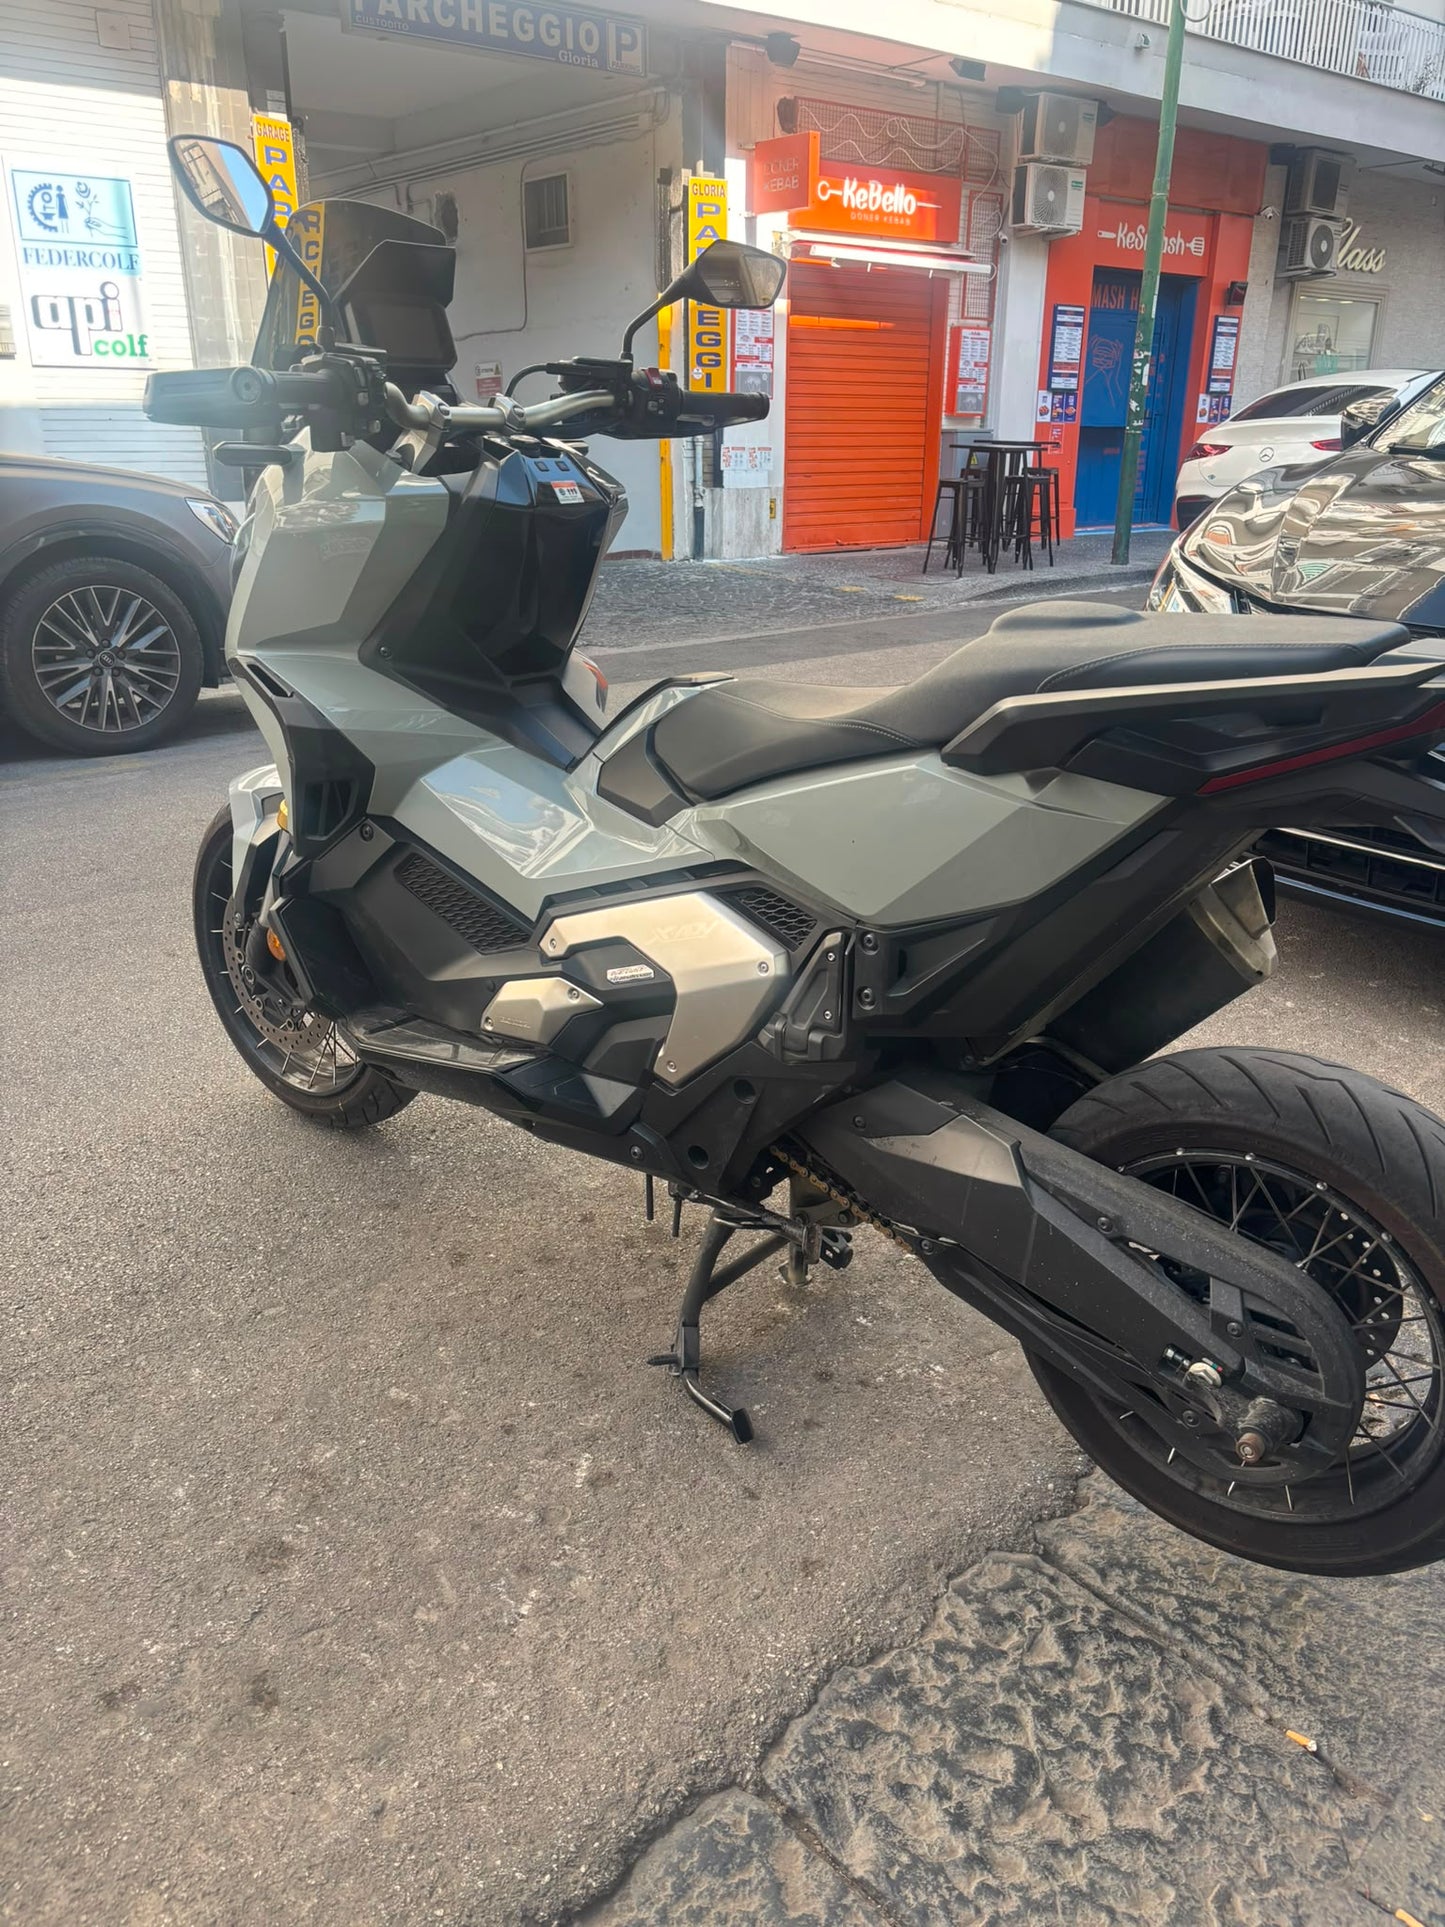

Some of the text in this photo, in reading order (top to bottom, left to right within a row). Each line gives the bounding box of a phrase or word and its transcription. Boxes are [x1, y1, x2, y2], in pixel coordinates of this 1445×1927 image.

[355, 14, 410, 31] CUSTODITO
[558, 49, 599, 68] Gloria
[256, 120, 290, 143] GARAGE
[691, 182, 726, 198] GLORIA
[842, 176, 917, 215] KeBello
[883, 214, 911, 226] KEBAB
[1116, 222, 1185, 256] KeSsh
[23, 247, 140, 271] FEDERCOLF
[94, 334, 149, 357] colf
